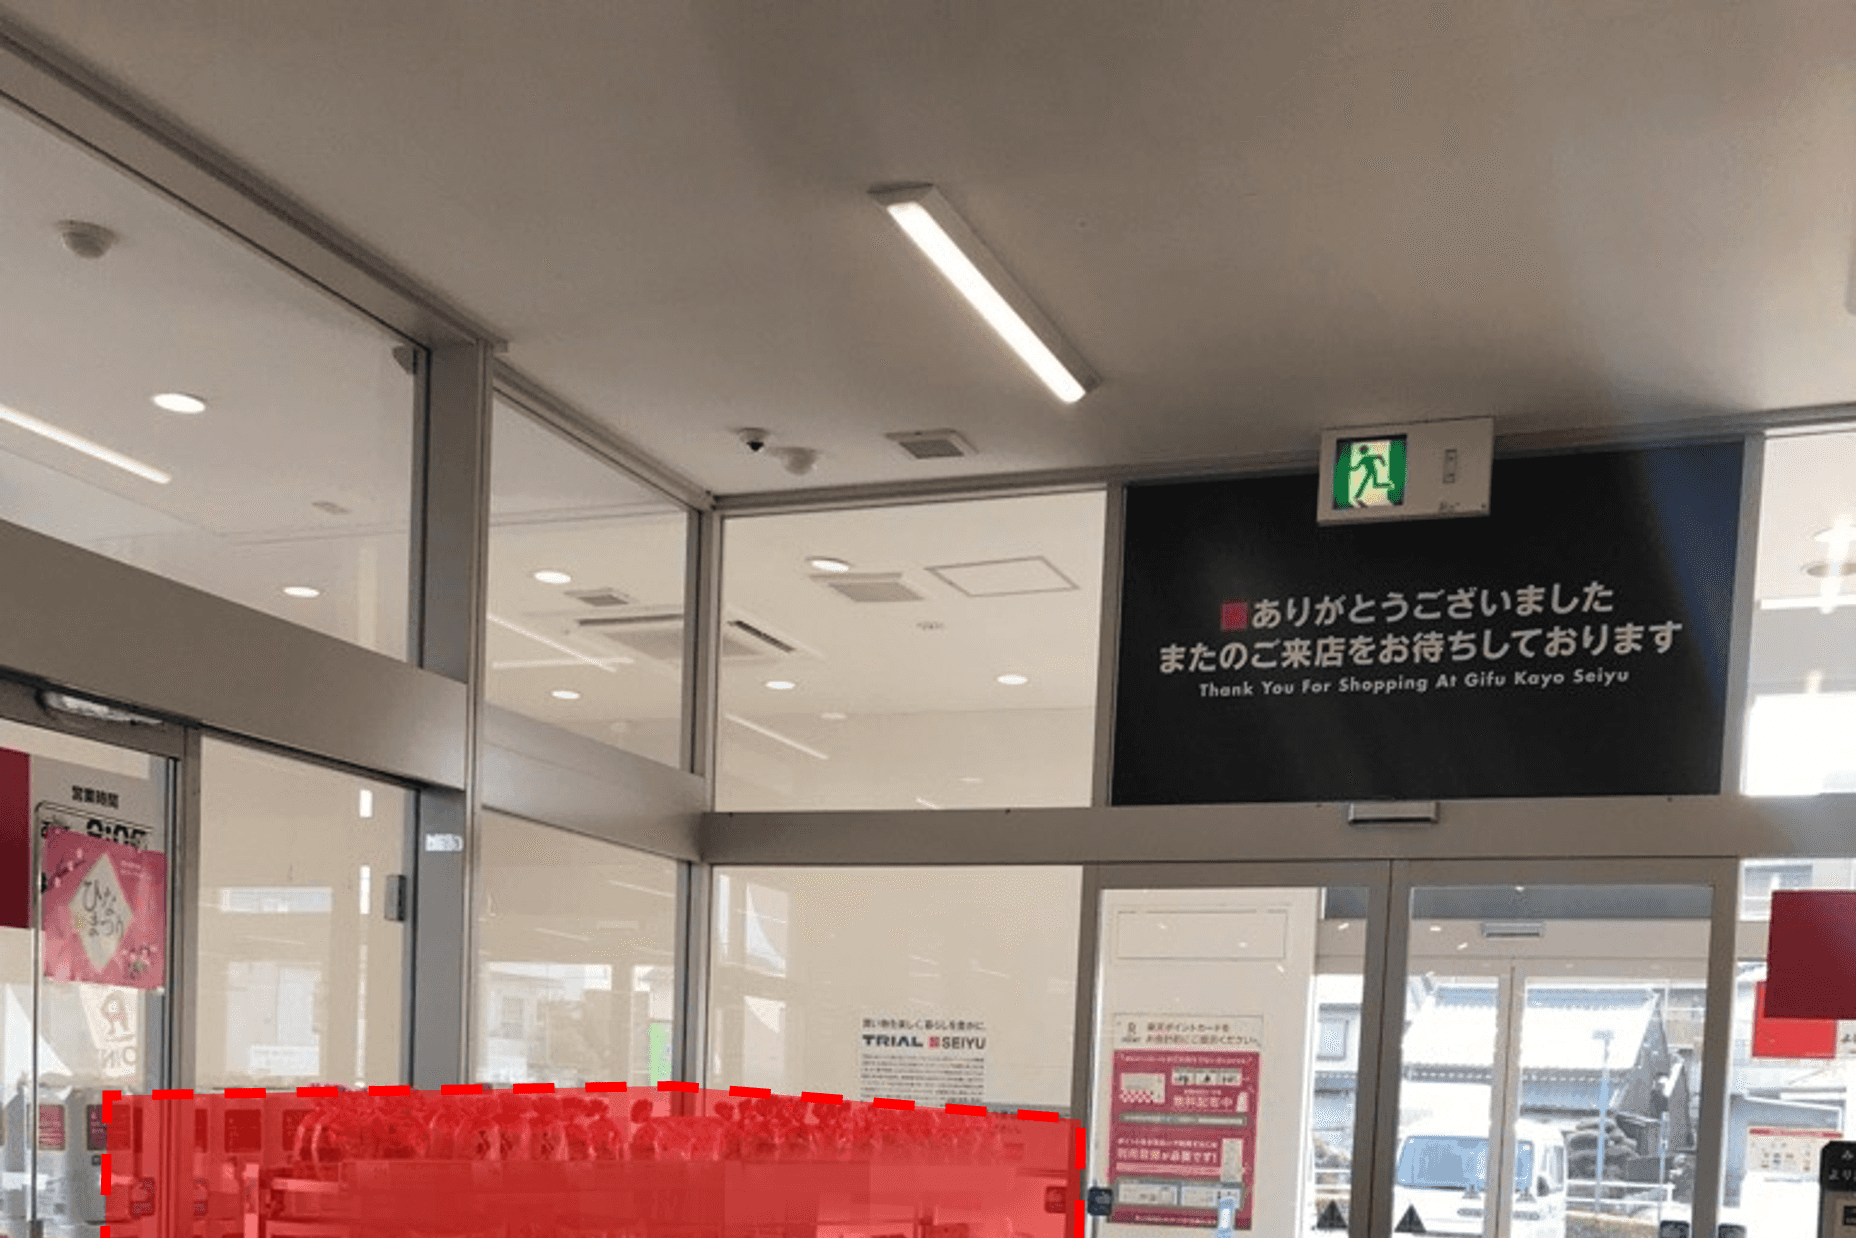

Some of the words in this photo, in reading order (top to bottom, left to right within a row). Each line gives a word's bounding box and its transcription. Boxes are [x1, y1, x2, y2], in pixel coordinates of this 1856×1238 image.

[1252, 581, 1613, 629] ありがとうございました
[1159, 620, 1682, 673] またのご来店をお待ちしております
[1199, 682, 1253, 698] Thank
[1261, 679, 1294, 696] You
[1301, 677, 1331, 694] For
[1338, 674, 1427, 697] Shopping
[1435, 675, 1457, 690] At
[1464, 671, 1506, 689] Gifu
[1513, 669, 1563, 687] Kayo
[1570, 667, 1629, 686] Seiyu
[862, 1034, 924, 1047] TRIAL
[942, 1036, 987, 1050] SEIYU
